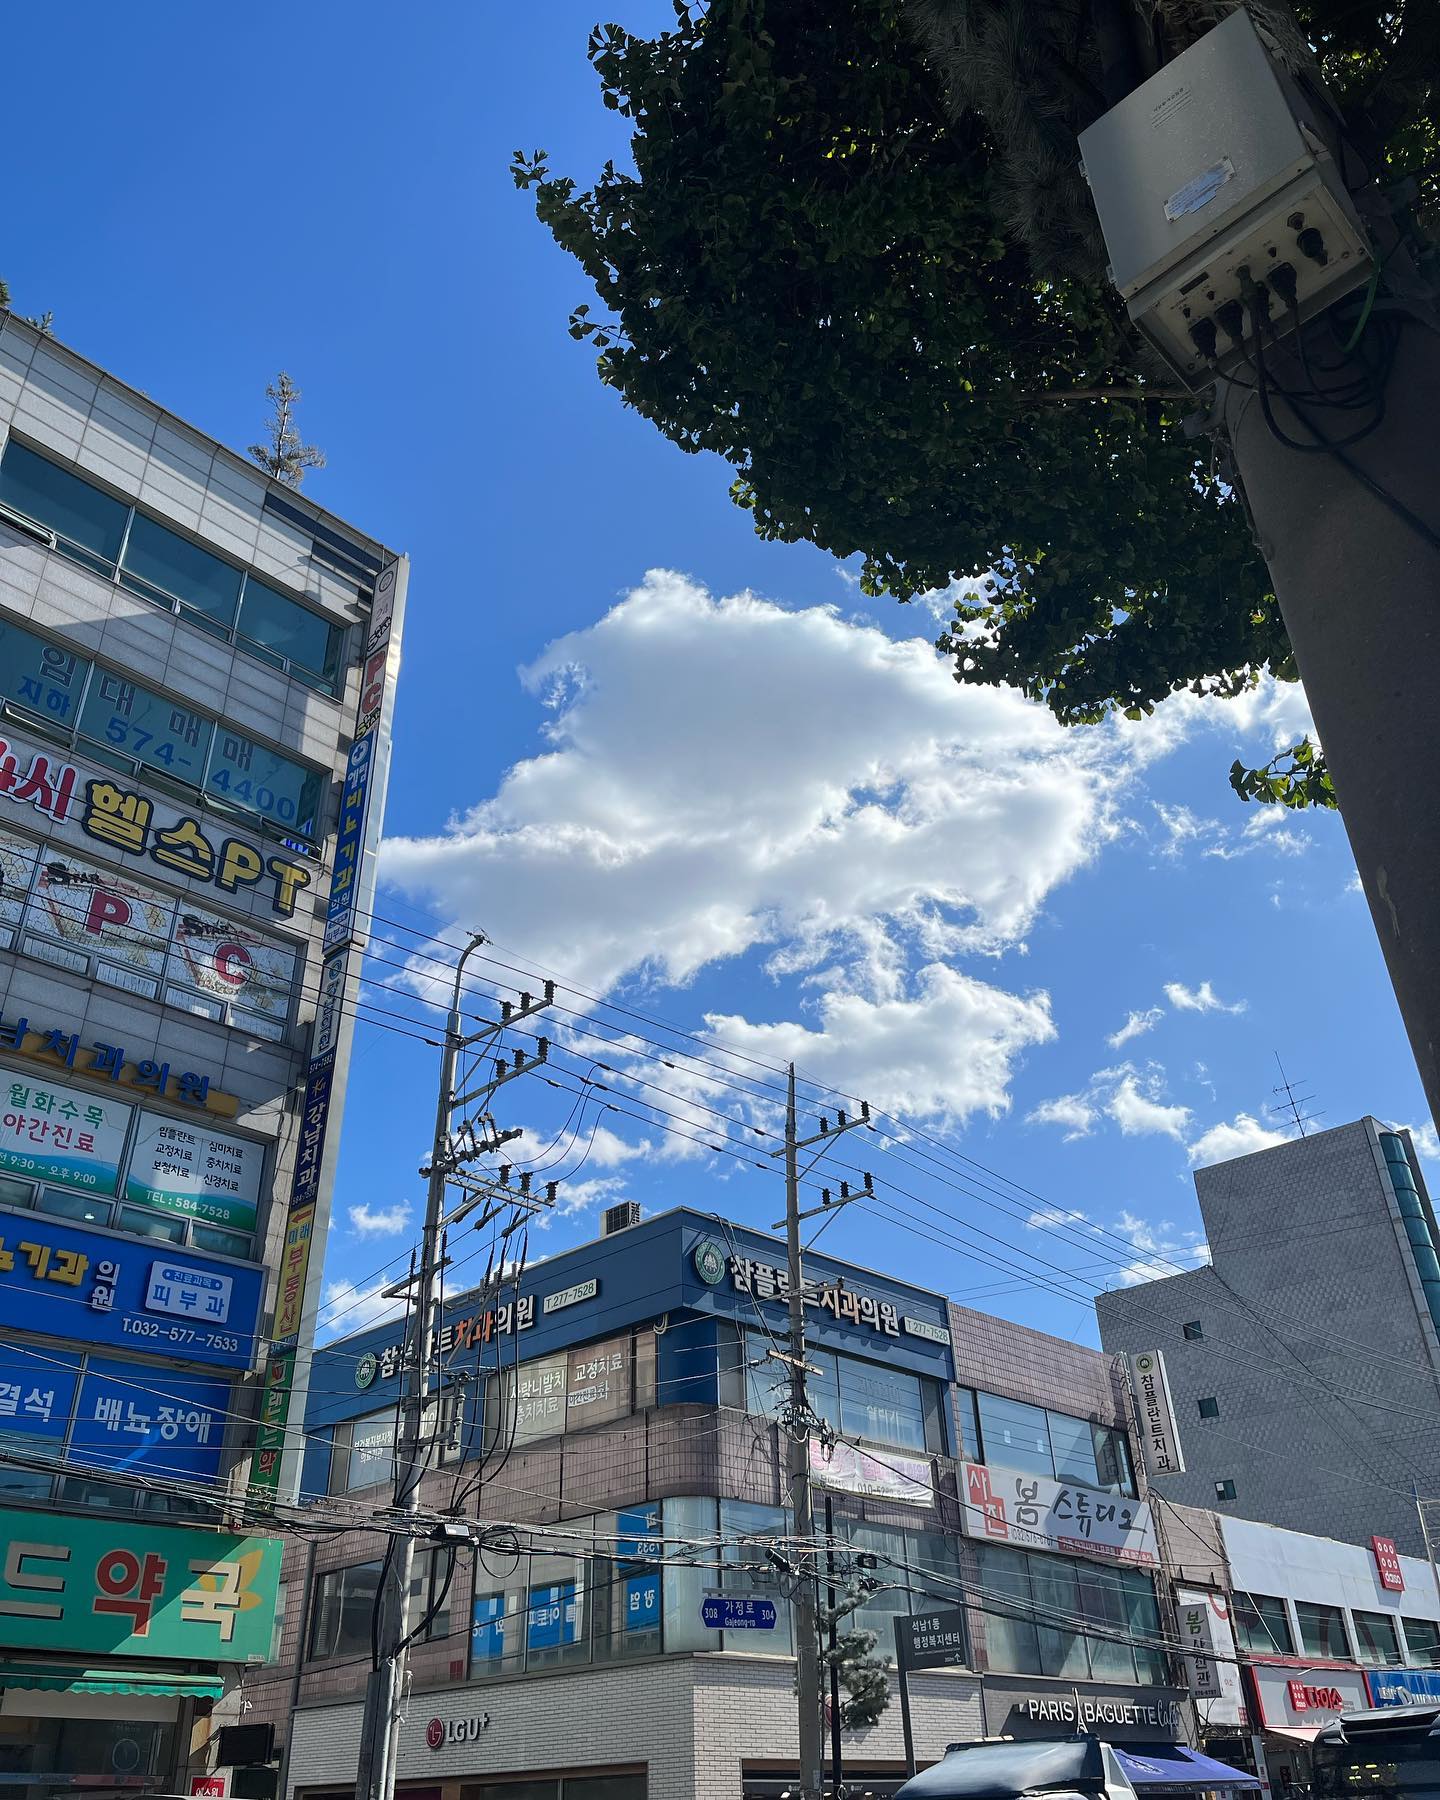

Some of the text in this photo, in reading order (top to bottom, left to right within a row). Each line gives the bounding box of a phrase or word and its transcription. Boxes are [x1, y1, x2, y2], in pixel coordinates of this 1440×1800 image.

[18, 674, 71, 718] 지하
[83, 777, 312, 918] 헬스PT
[9, 1083, 104, 1130] 월화수목
[3, 1113, 95, 1153] 야간진료
[159, 1126, 196, 1145] 임플란트
[155, 1143, 193, 1161] 교정치료
[208, 1141, 244, 1159] 심미치료
[11, 1156, 35, 1170] 9:30
[48, 1166, 70, 1179] 오후
[74, 1171, 96, 1185] 9:00
[152, 1159, 190, 1179] 보철치료
[205, 1156, 242, 1175] 충치치료
[203, 1173, 240, 1192] 신경치료
[175, 1197, 230, 1220] 584-7528
[174, 1271, 212, 1289] 진료과목
[152, 1284, 225, 1317] 피부과
[122, 1317, 239, 1352] T.032-577-7533
[574, 1353, 623, 1382] 교정치료
[1140, 1374, 1171, 1471] 참플란트치과
[968, 1468, 1007, 1537] 사진
[1014, 1477, 1147, 1538] 봄 스튜디오
[704, 1607, 718, 1619] 308
[725, 1600, 755, 1616] 가정로
[761, 1609, 775, 1620] 304
[724, 1616, 756, 1628] Gajeong-ro
[911, 1617, 940, 1633] 석남1동
[913, 1632, 961, 1650] 행정복지센터
[1028, 1699, 1075, 1722] PARIS
[1084, 1702, 1158, 1726] BAGUETTE
